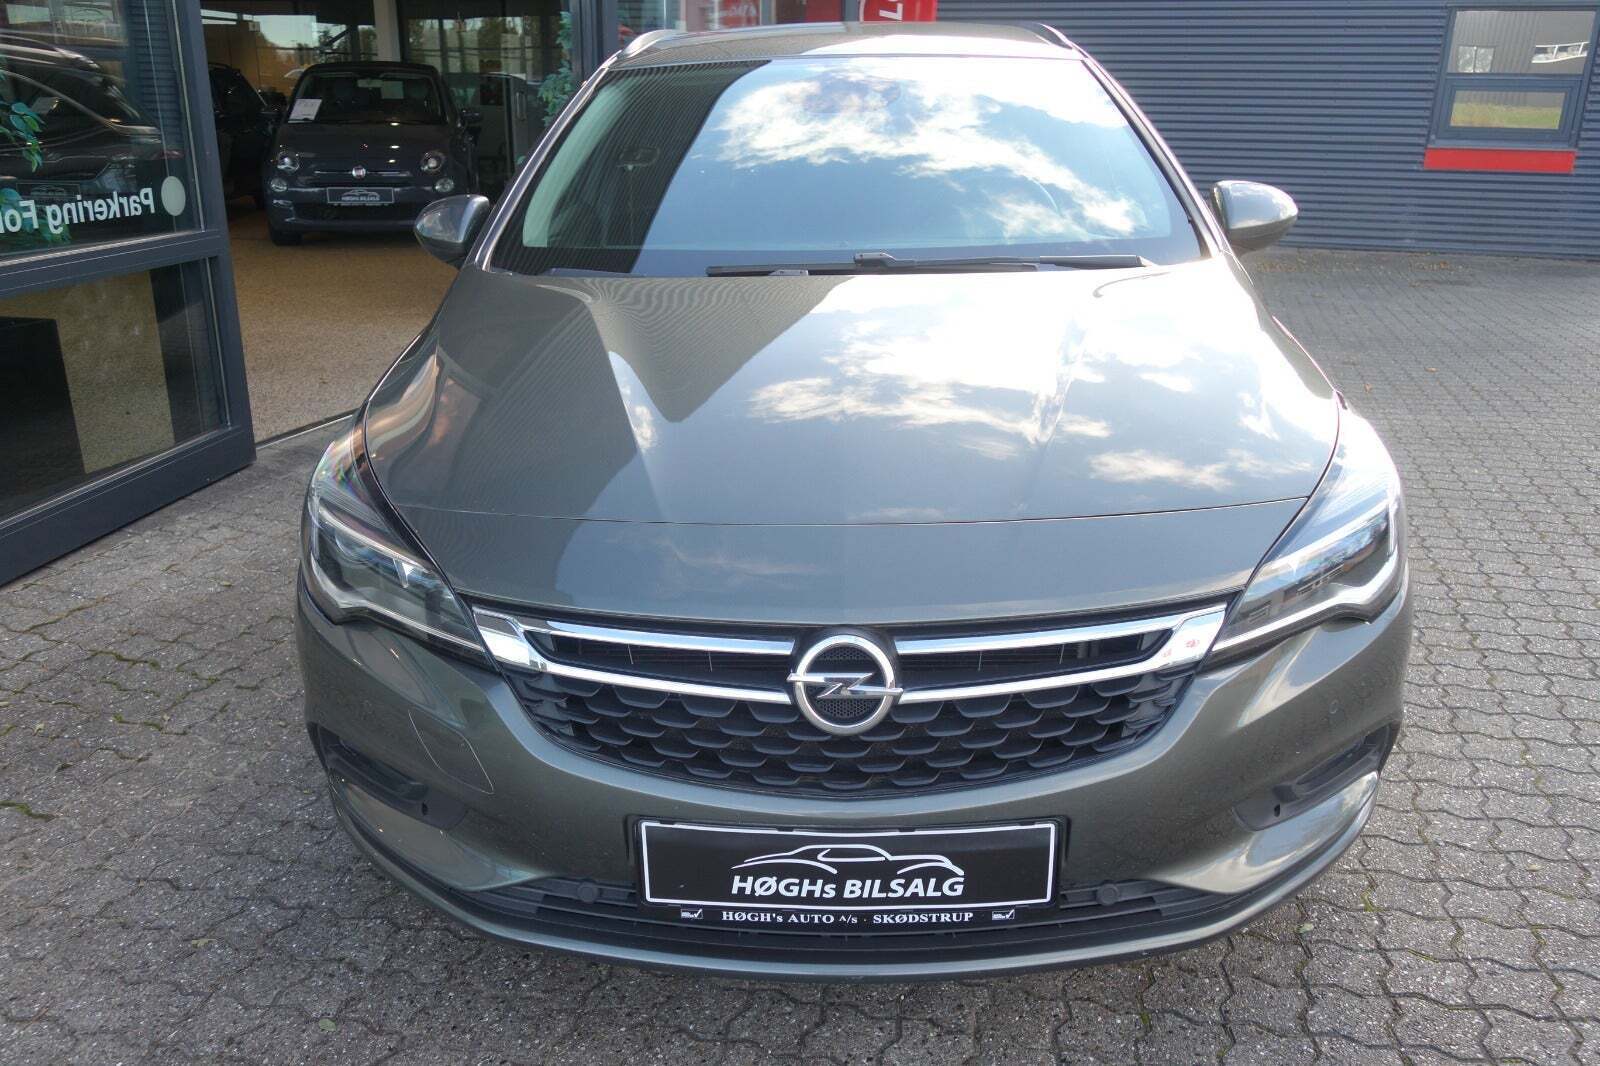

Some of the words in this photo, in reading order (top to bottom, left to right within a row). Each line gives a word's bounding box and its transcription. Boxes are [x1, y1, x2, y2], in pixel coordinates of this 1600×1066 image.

[731, 875, 837, 898] HØGHs
[843, 877, 965, 898] BILSALG
[721, 911, 783, 923] HØGH's
[788, 913, 835, 923] AUTO
[873, 912, 974, 924] SKØDSTRUP
